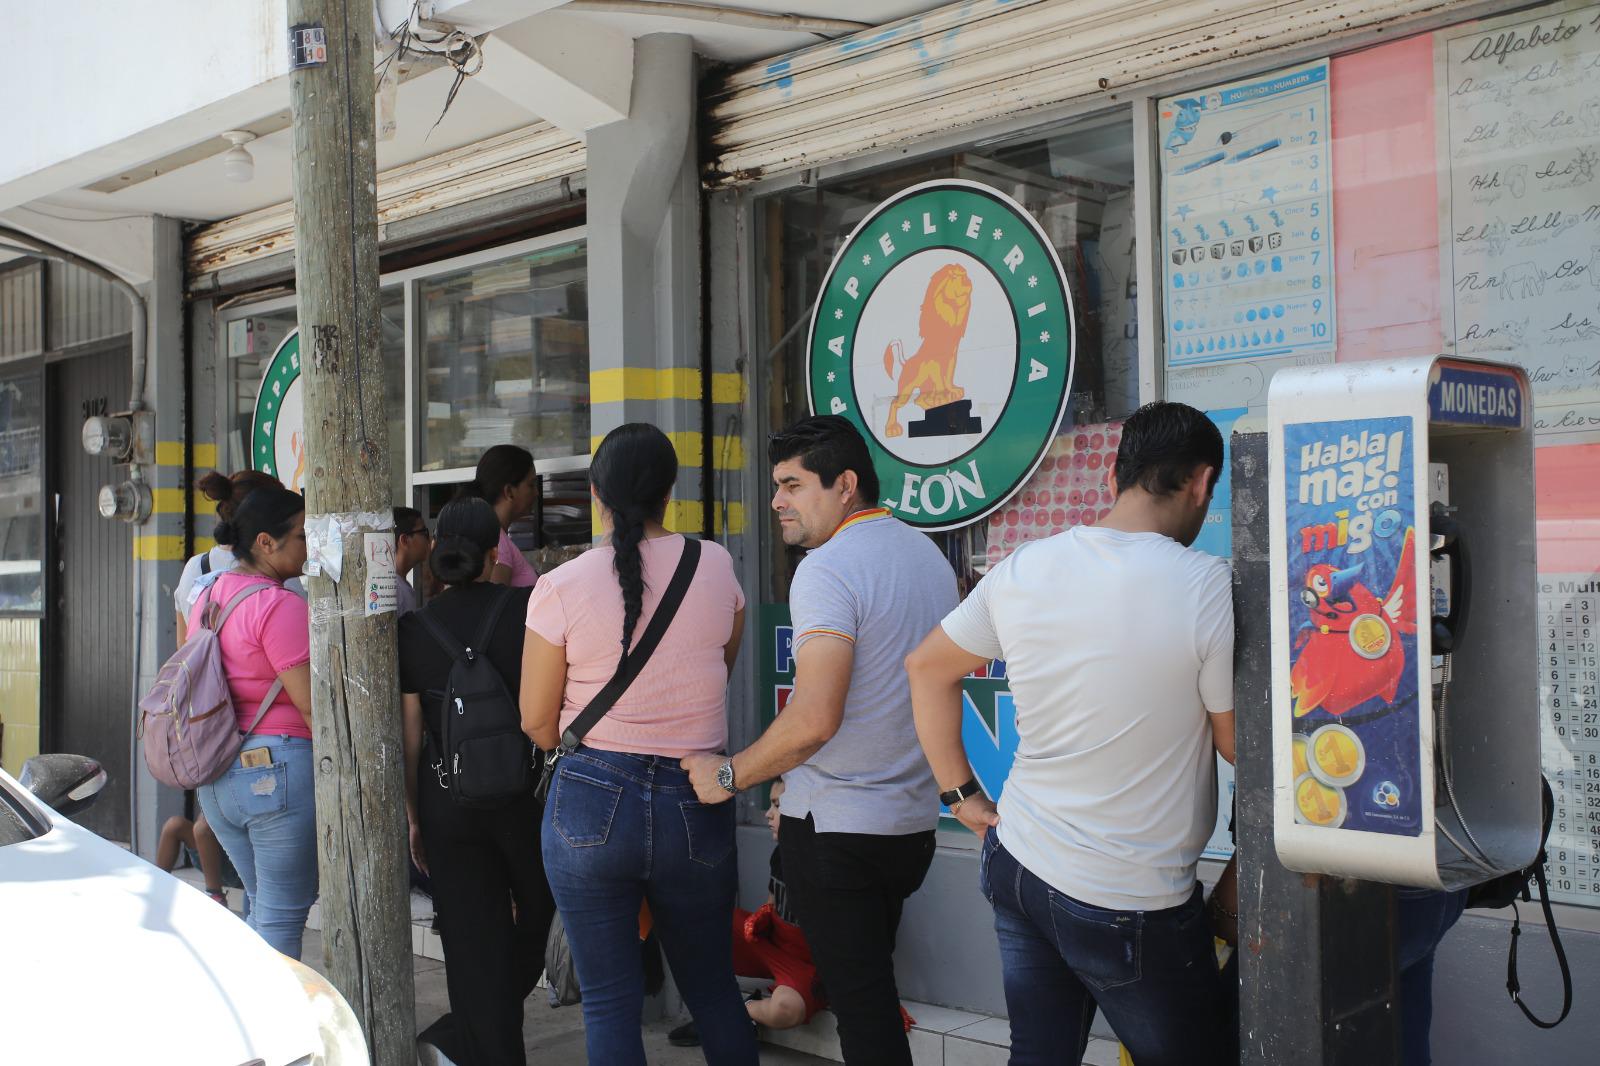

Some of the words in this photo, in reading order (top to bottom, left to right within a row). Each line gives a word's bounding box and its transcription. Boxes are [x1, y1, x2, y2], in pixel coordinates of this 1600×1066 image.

[1461, 19, 1582, 64] Alfabeto
[1308, 107, 1314, 122] 1
[1308, 130, 1318, 145] 2
[1309, 154, 1319, 170] 3
[1308, 178, 1319, 192] 4
[1310, 202, 1319, 217] 5
[1311, 227, 1320, 241] 6
[1311, 250, 1320, 265] 7
[1312, 275, 1321, 289] 8
[1312, 299, 1321, 314] 9
[1311, 322, 1326, 337] 10
[1440, 381, 1517, 418] MONEDAS
[1300, 430, 1386, 472] Habla
[1356, 490, 1398, 511] con
[1300, 509, 1402, 554] migo
[1581, 601, 1589, 611] 3
[1582, 614, 1589, 625] 6
[1549, 629, 1556, 639] 3
[1583, 629, 1590, 639] 9
[1549, 642, 1556, 652] 4
[1581, 643, 1595, 653] 12
[1550, 656, 1558, 667] 5
[1582, 657, 1596, 667] 15
[1551, 670, 1559, 680] 6
[1583, 671, 1596, 681] 18
[1552, 684, 1559, 694] 7
[1582, 685, 1596, 695] 21
[1553, 698, 1560, 708] 8
[1584, 699, 1598, 709] 24
[1554, 712, 1561, 722] 9
[1584, 713, 1598, 723] 27
[1584, 727, 1598, 738] 30
[1589, 754, 1596, 765] 8
[1556, 766, 1564, 776] 2
[1586, 768, 1600, 779] 16
[1557, 780, 1565, 790] 3
[1586, 783, 1600, 793] 24
[1558, 794, 1565, 804] 4
[1587, 797, 1600, 807] 32
[1558, 809, 1566, 818] 5
[1588, 811, 1600, 822] 40
[1559, 823, 1566, 832] 6
[1590, 825, 1600, 835] 48
[1559, 851, 1567, 861] 8
[1559, 866, 1567, 875] 9
[1557, 880, 1571, 890] 10
